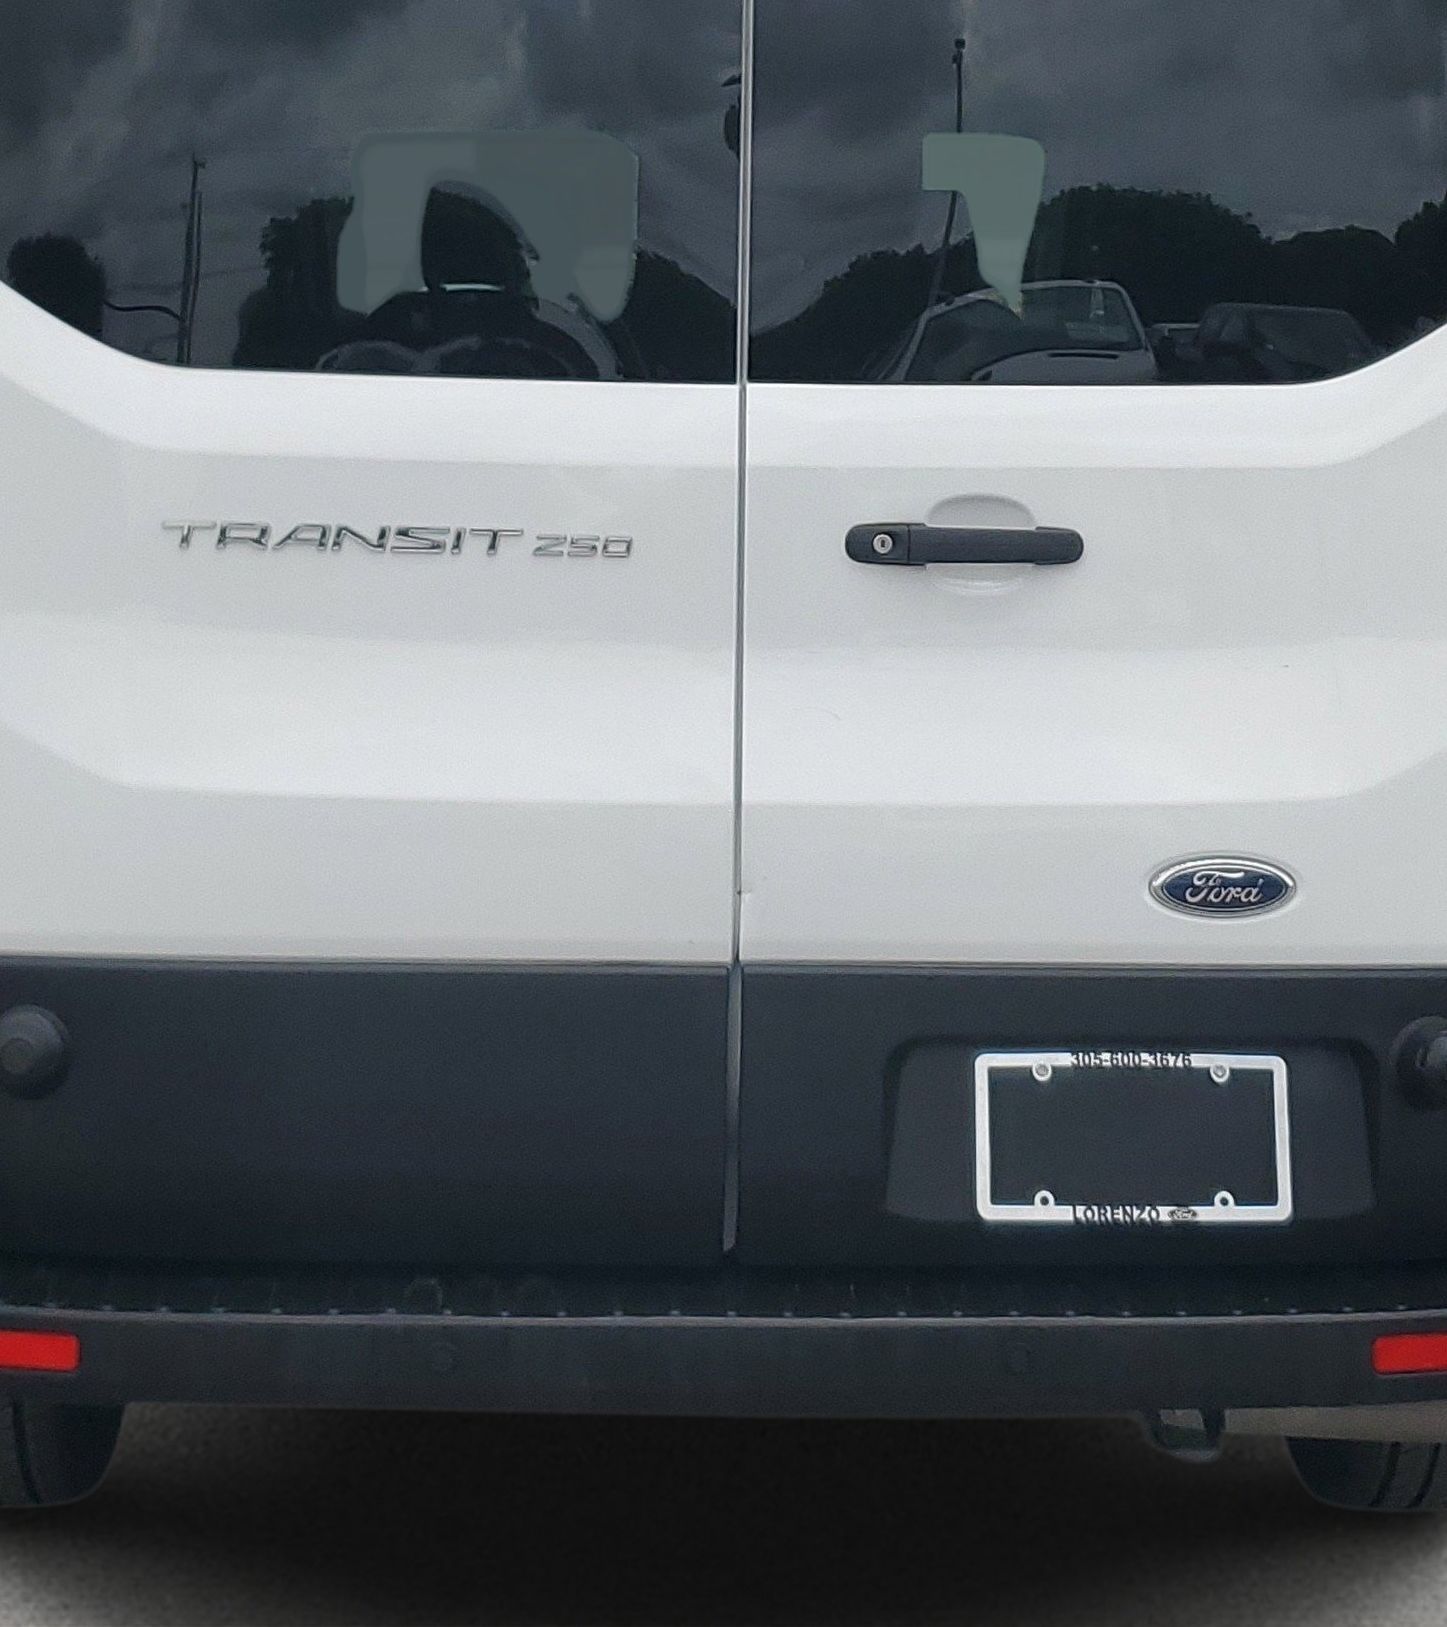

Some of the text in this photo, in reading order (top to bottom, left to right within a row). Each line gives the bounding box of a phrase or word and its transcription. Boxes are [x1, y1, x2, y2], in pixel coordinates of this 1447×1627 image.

[162, 521, 634, 558] TRANSIT 250
[1185, 870, 1264, 903] Ford
[1072, 1204, 1161, 1224] LORENZO
